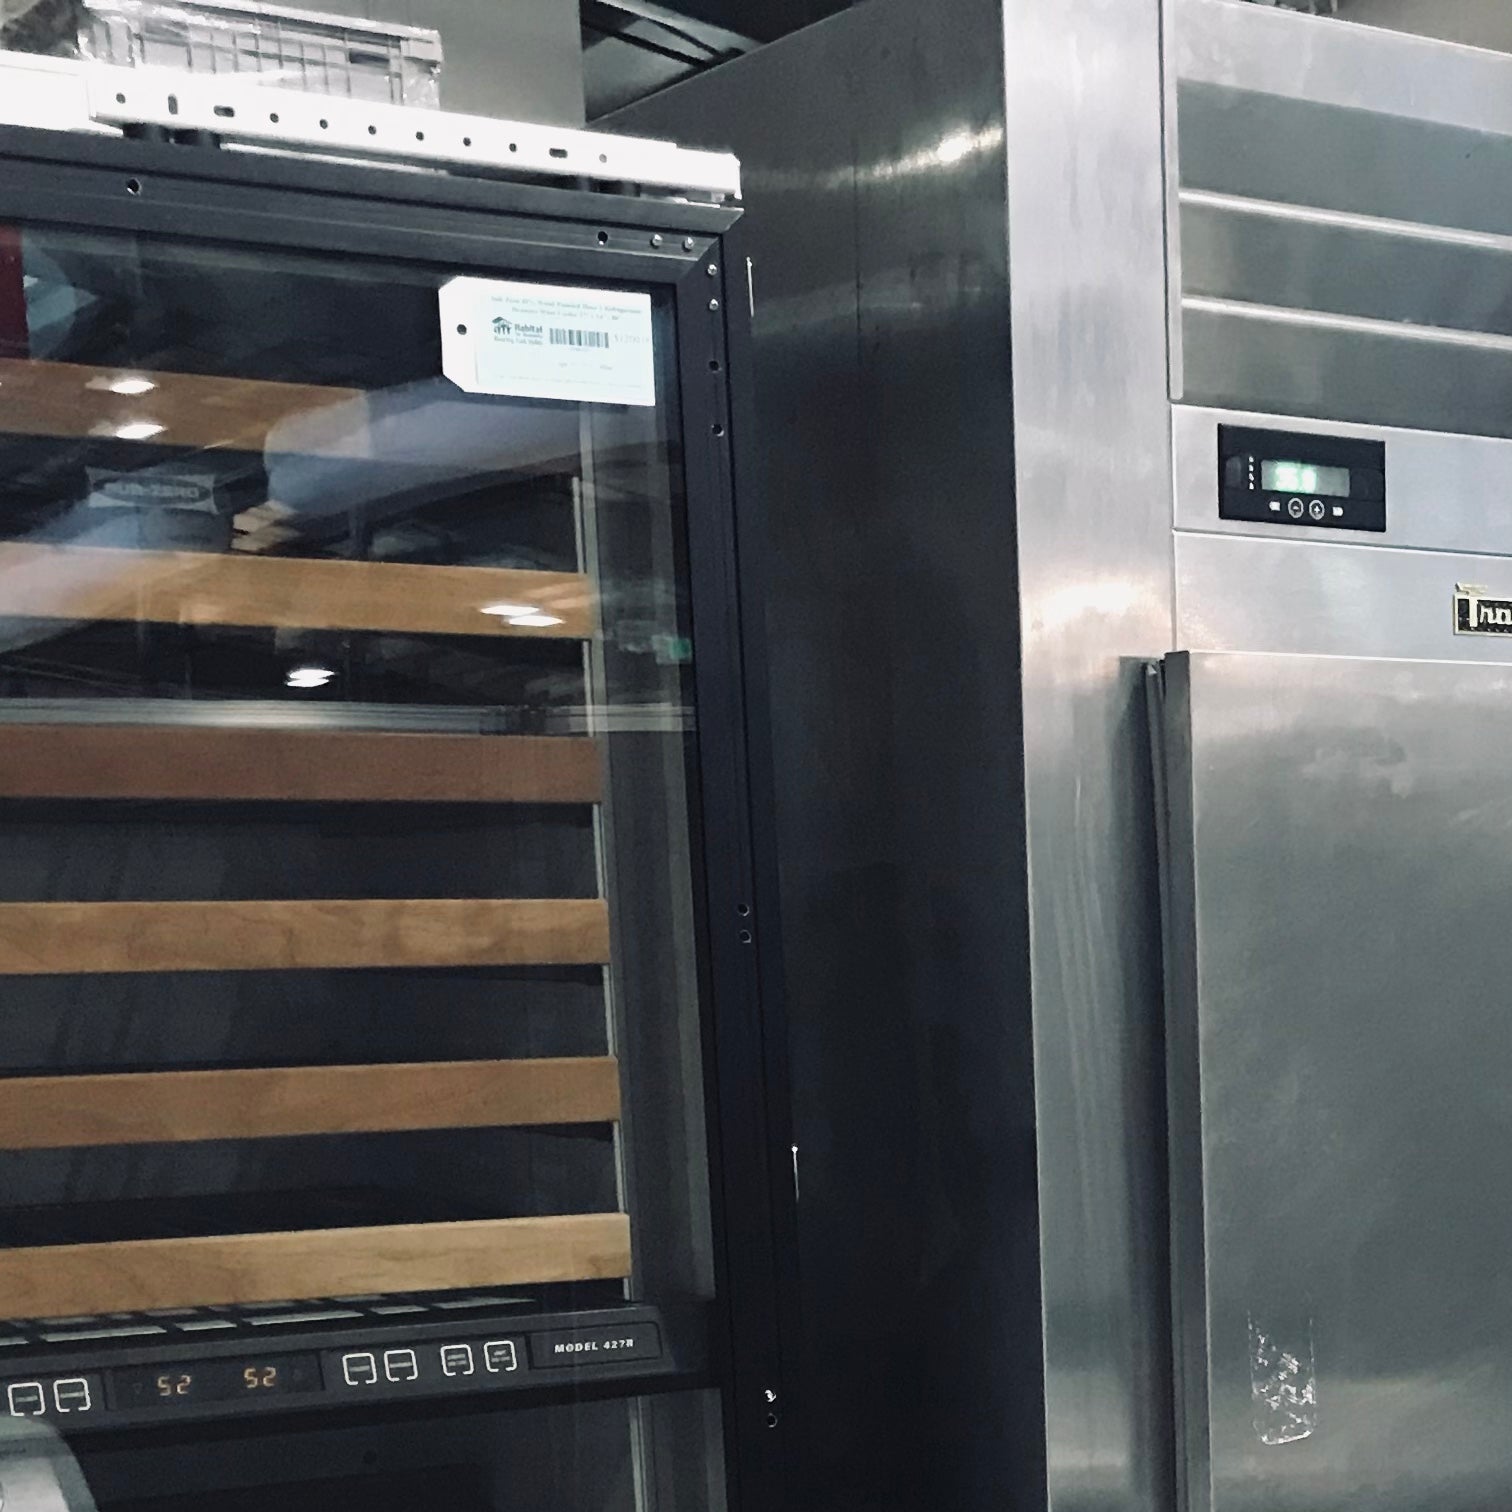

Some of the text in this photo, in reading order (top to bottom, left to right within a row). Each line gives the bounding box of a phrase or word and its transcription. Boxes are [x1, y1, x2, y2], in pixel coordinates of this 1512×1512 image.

[554, 1338, 634, 1353] MODEL 427R
[157, 1375, 192, 1396] 52
[244, 1366, 276, 1388] 52
